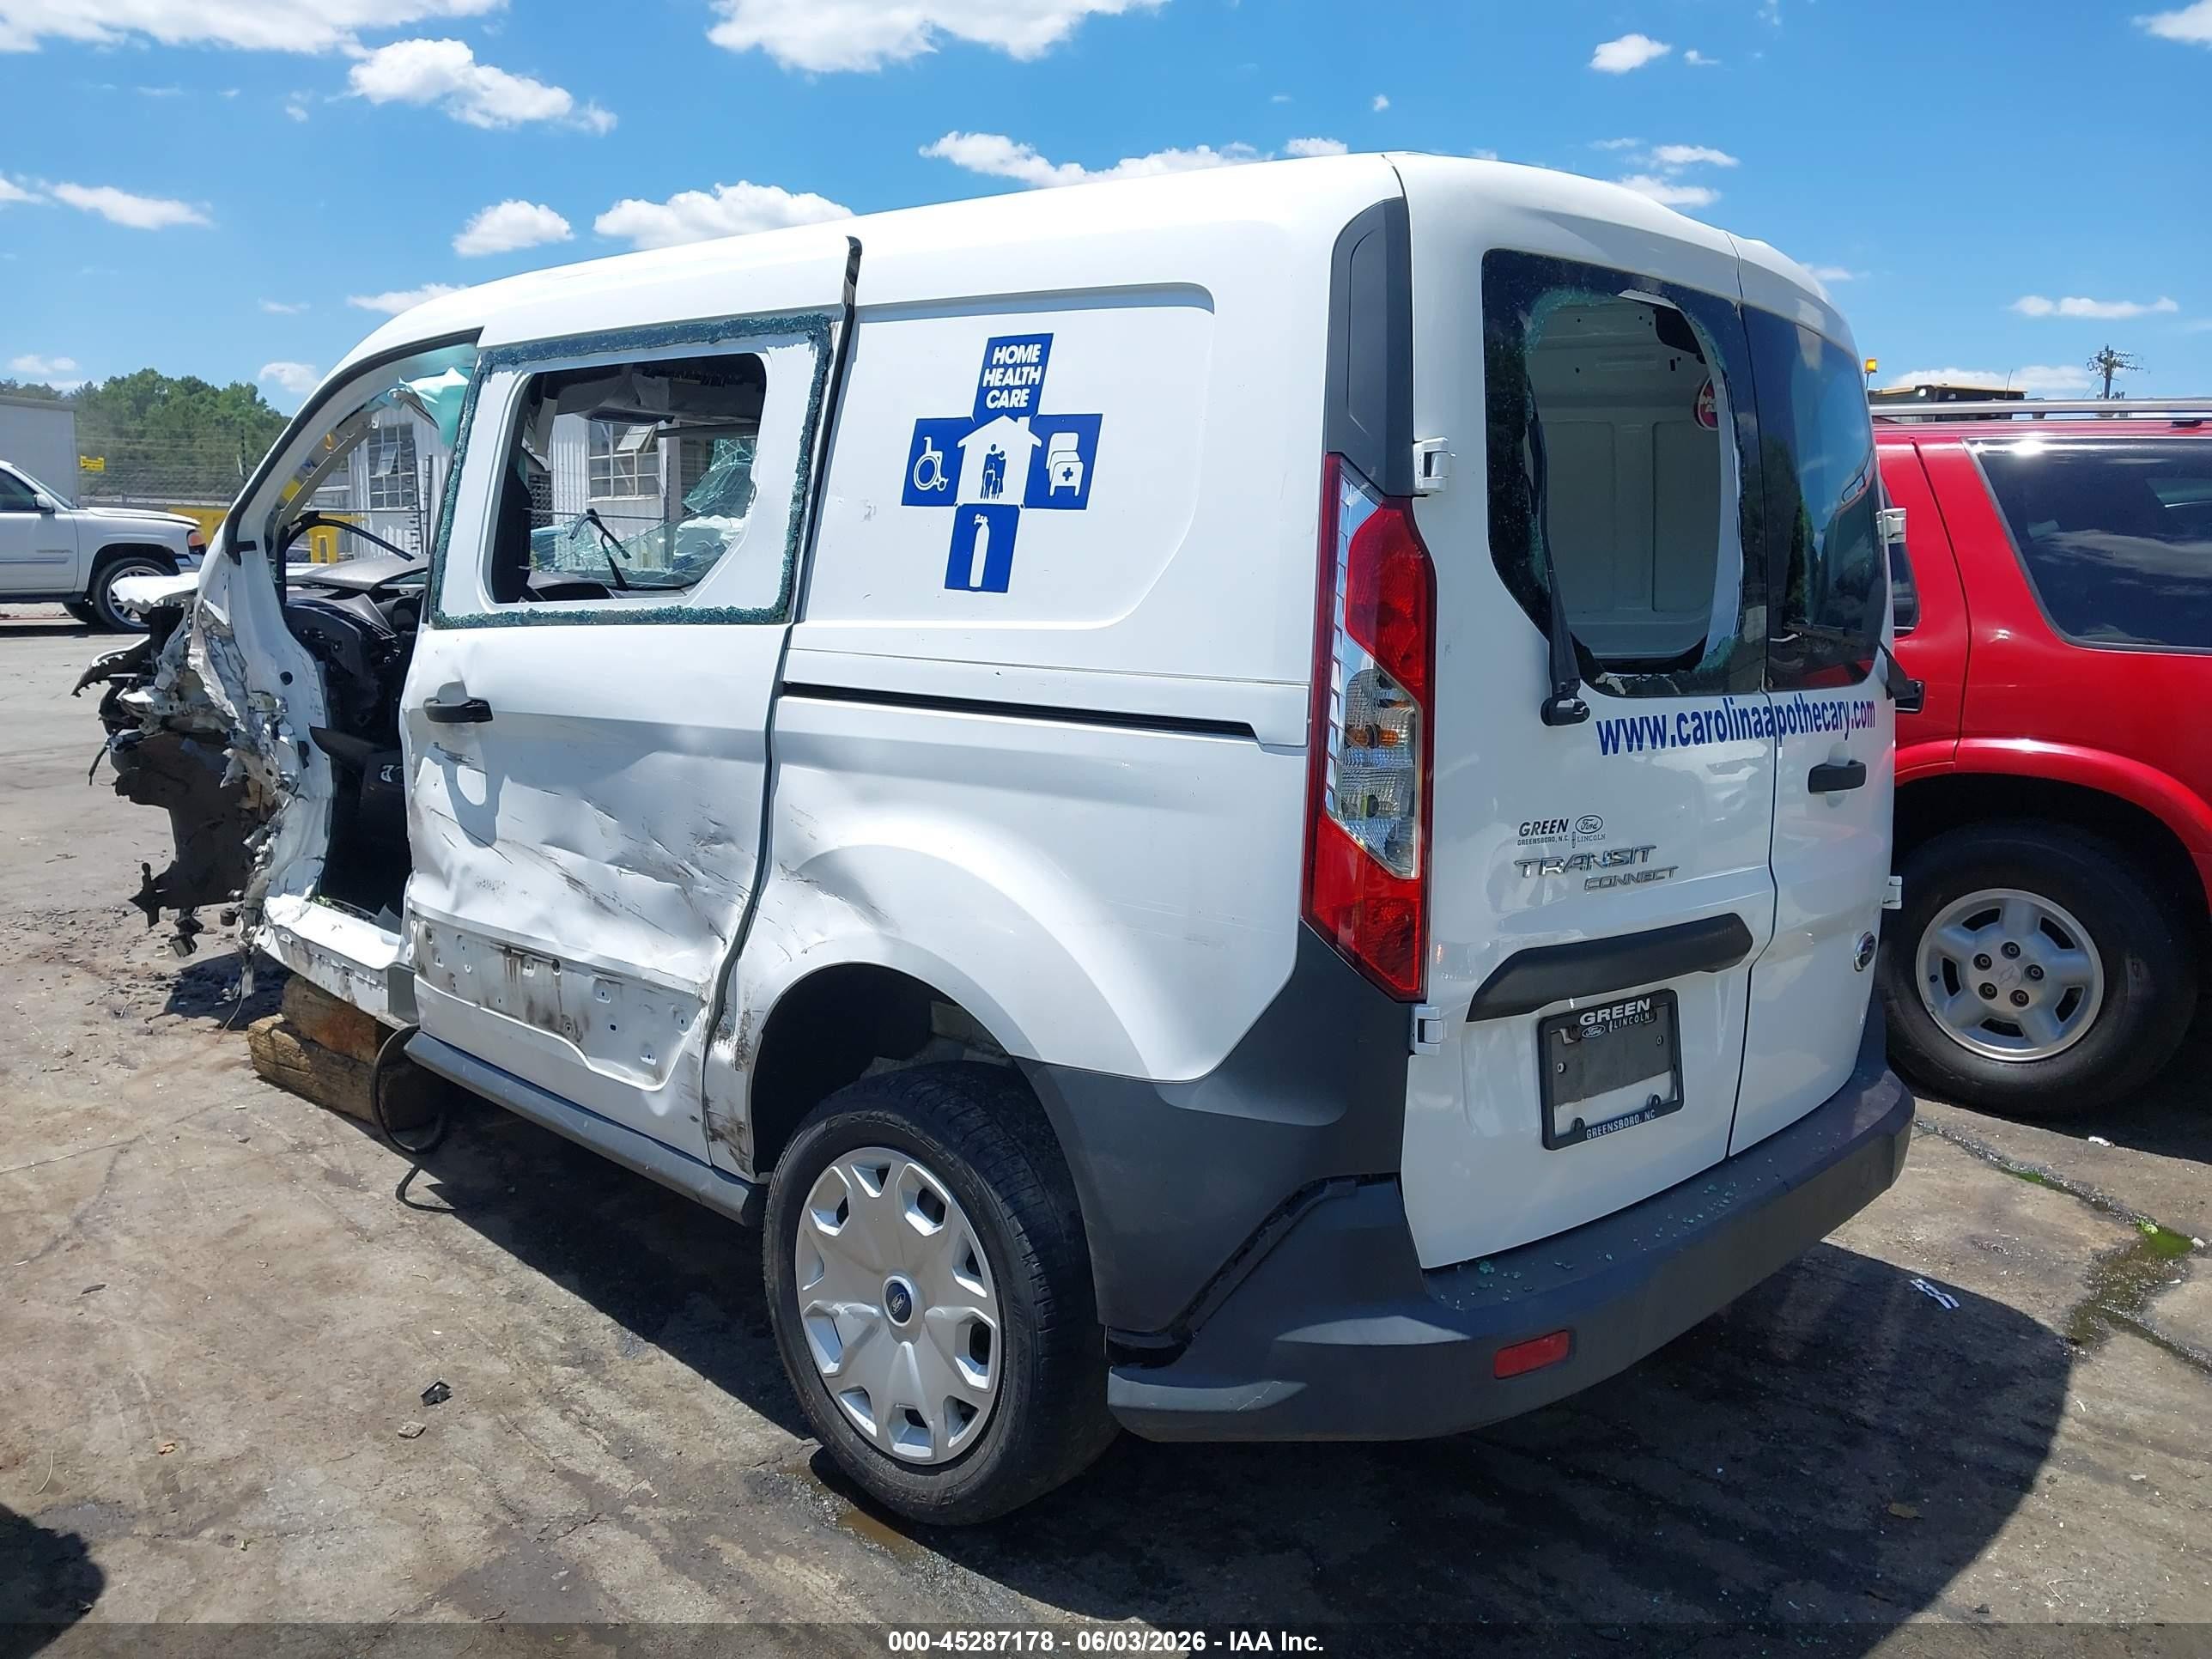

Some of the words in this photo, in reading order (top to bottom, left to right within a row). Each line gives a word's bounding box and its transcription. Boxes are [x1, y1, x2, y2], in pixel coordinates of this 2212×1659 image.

[992, 343, 1042, 365] HOME
[982, 366, 1042, 387] HEALTH
[986, 388, 1030, 409] CARE
[1595, 693, 1875, 756] www.carolinaapothecary.com
[1518, 819, 1569, 837] GREEN
[1577, 833, 1606, 843] LINCOLN
[1515, 845, 1657, 878] TRANSIT
[1584, 866, 1680, 890] CONNECT
[1579, 998, 1650, 1026] GREEN
[1613, 1012, 1650, 1030] LINCOLN
